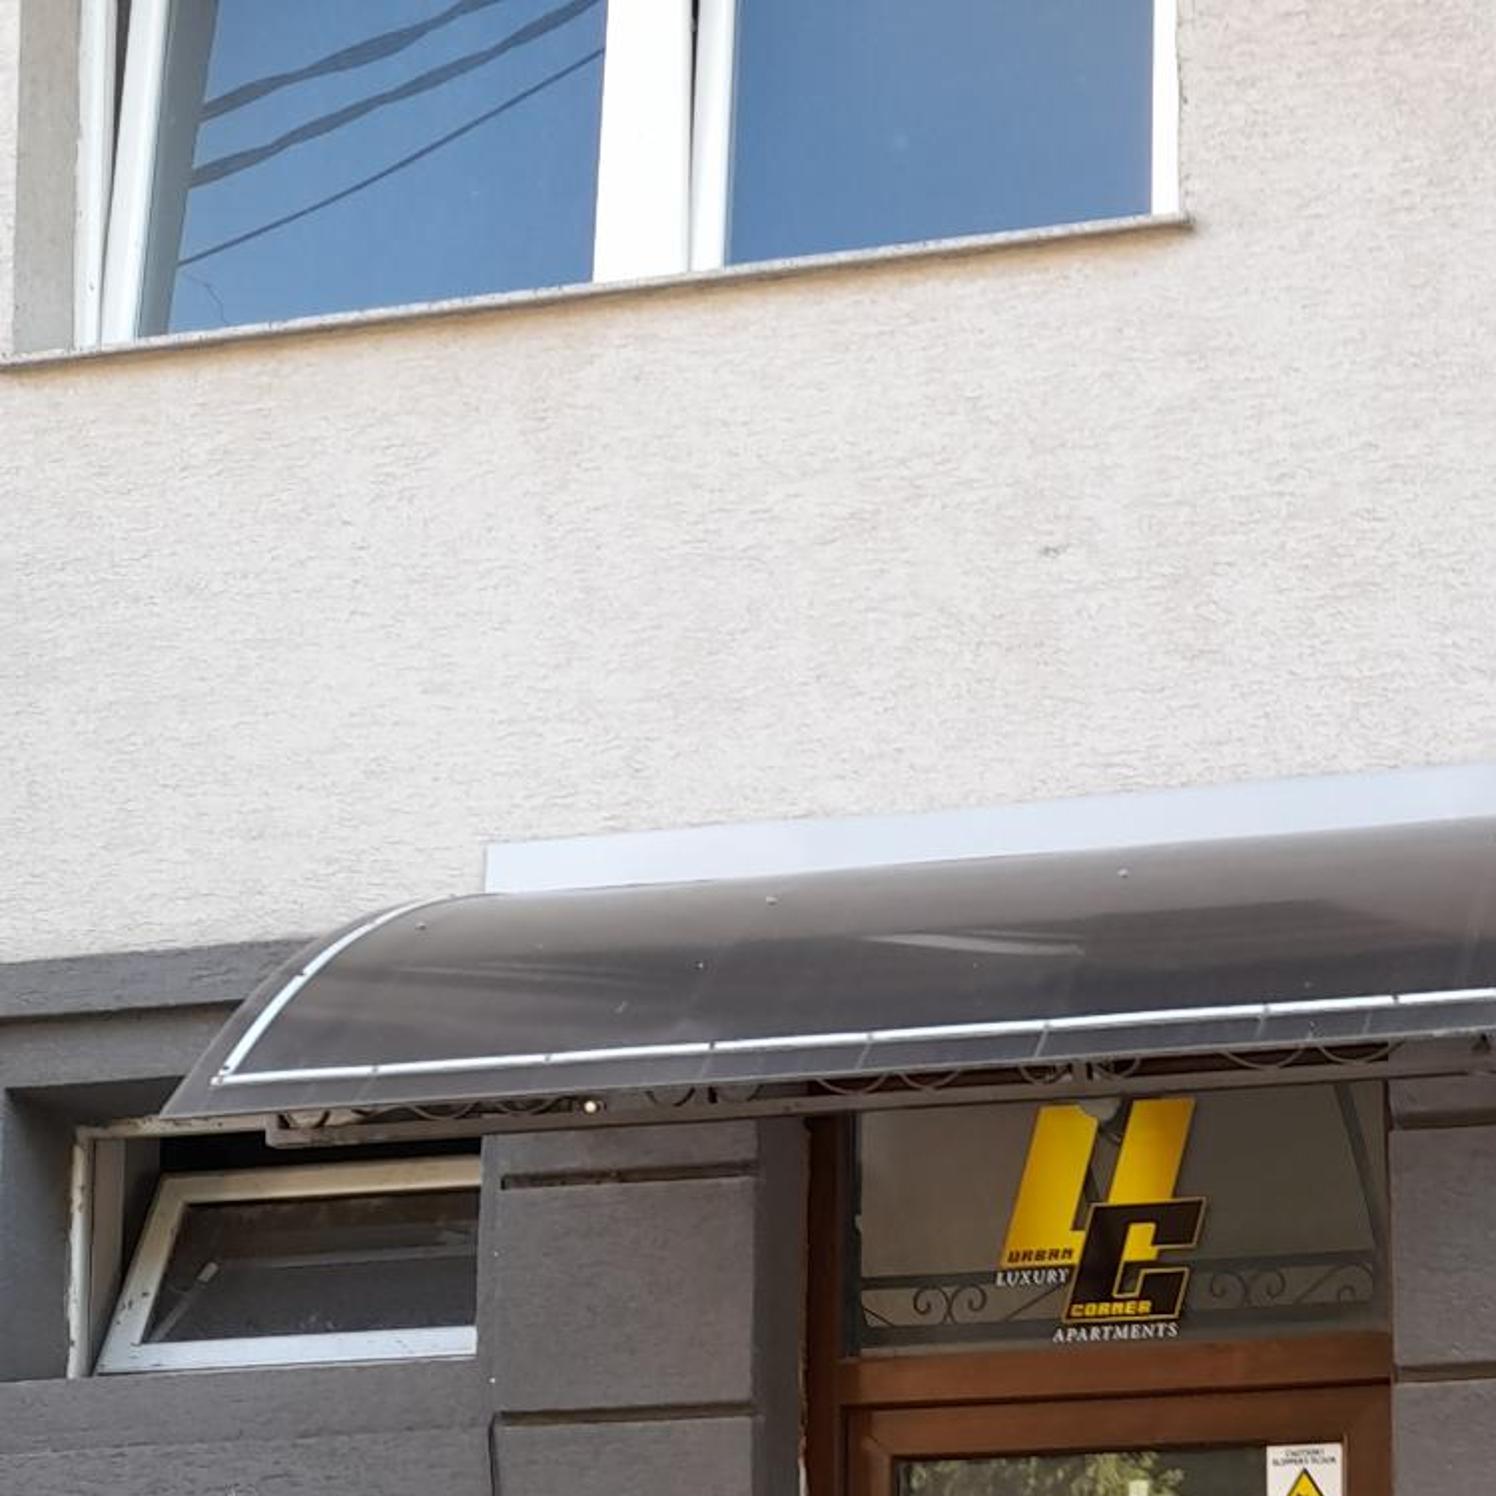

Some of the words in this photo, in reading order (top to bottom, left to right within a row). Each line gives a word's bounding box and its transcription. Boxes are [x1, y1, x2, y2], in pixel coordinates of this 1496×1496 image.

[1006, 1247, 1075, 1264] URBAN
[996, 1268, 1070, 1287] LUXURY
[1070, 1300, 1153, 1317] CORNER
[1052, 1321, 1181, 1343] APARTMENTS
